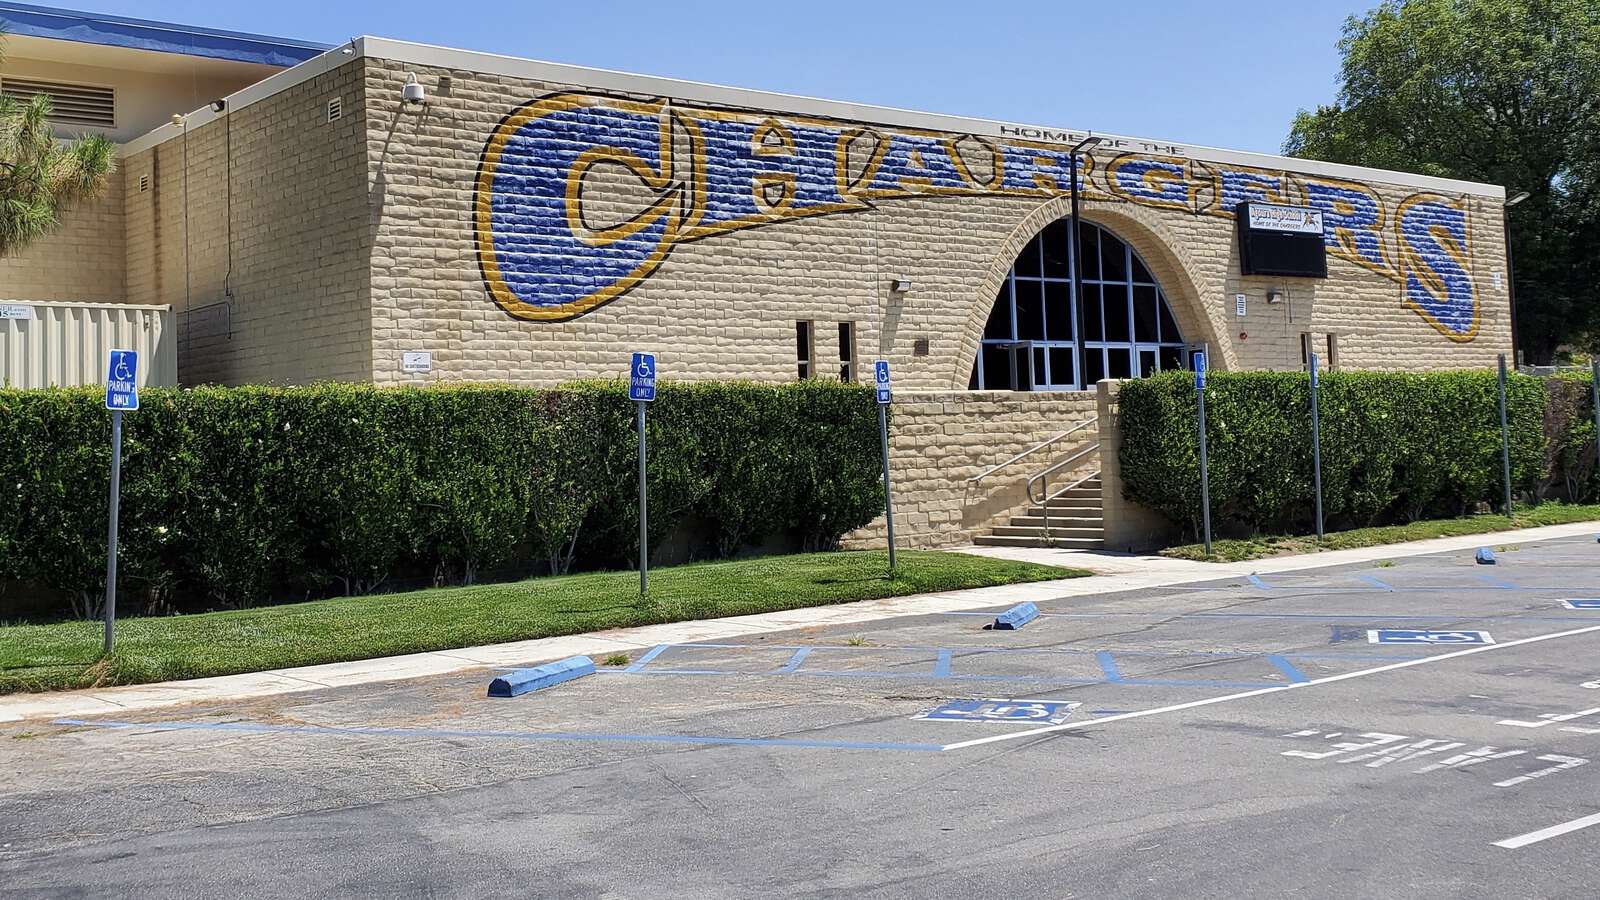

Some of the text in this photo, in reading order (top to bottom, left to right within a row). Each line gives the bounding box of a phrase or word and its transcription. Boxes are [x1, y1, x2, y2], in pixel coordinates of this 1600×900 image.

[1000, 125, 1185, 156] HOME OF THE
[472, 90, 1480, 343] CHARGERS
[113, 393, 129, 406] ONLY
[636, 388, 650, 397] ONLY
